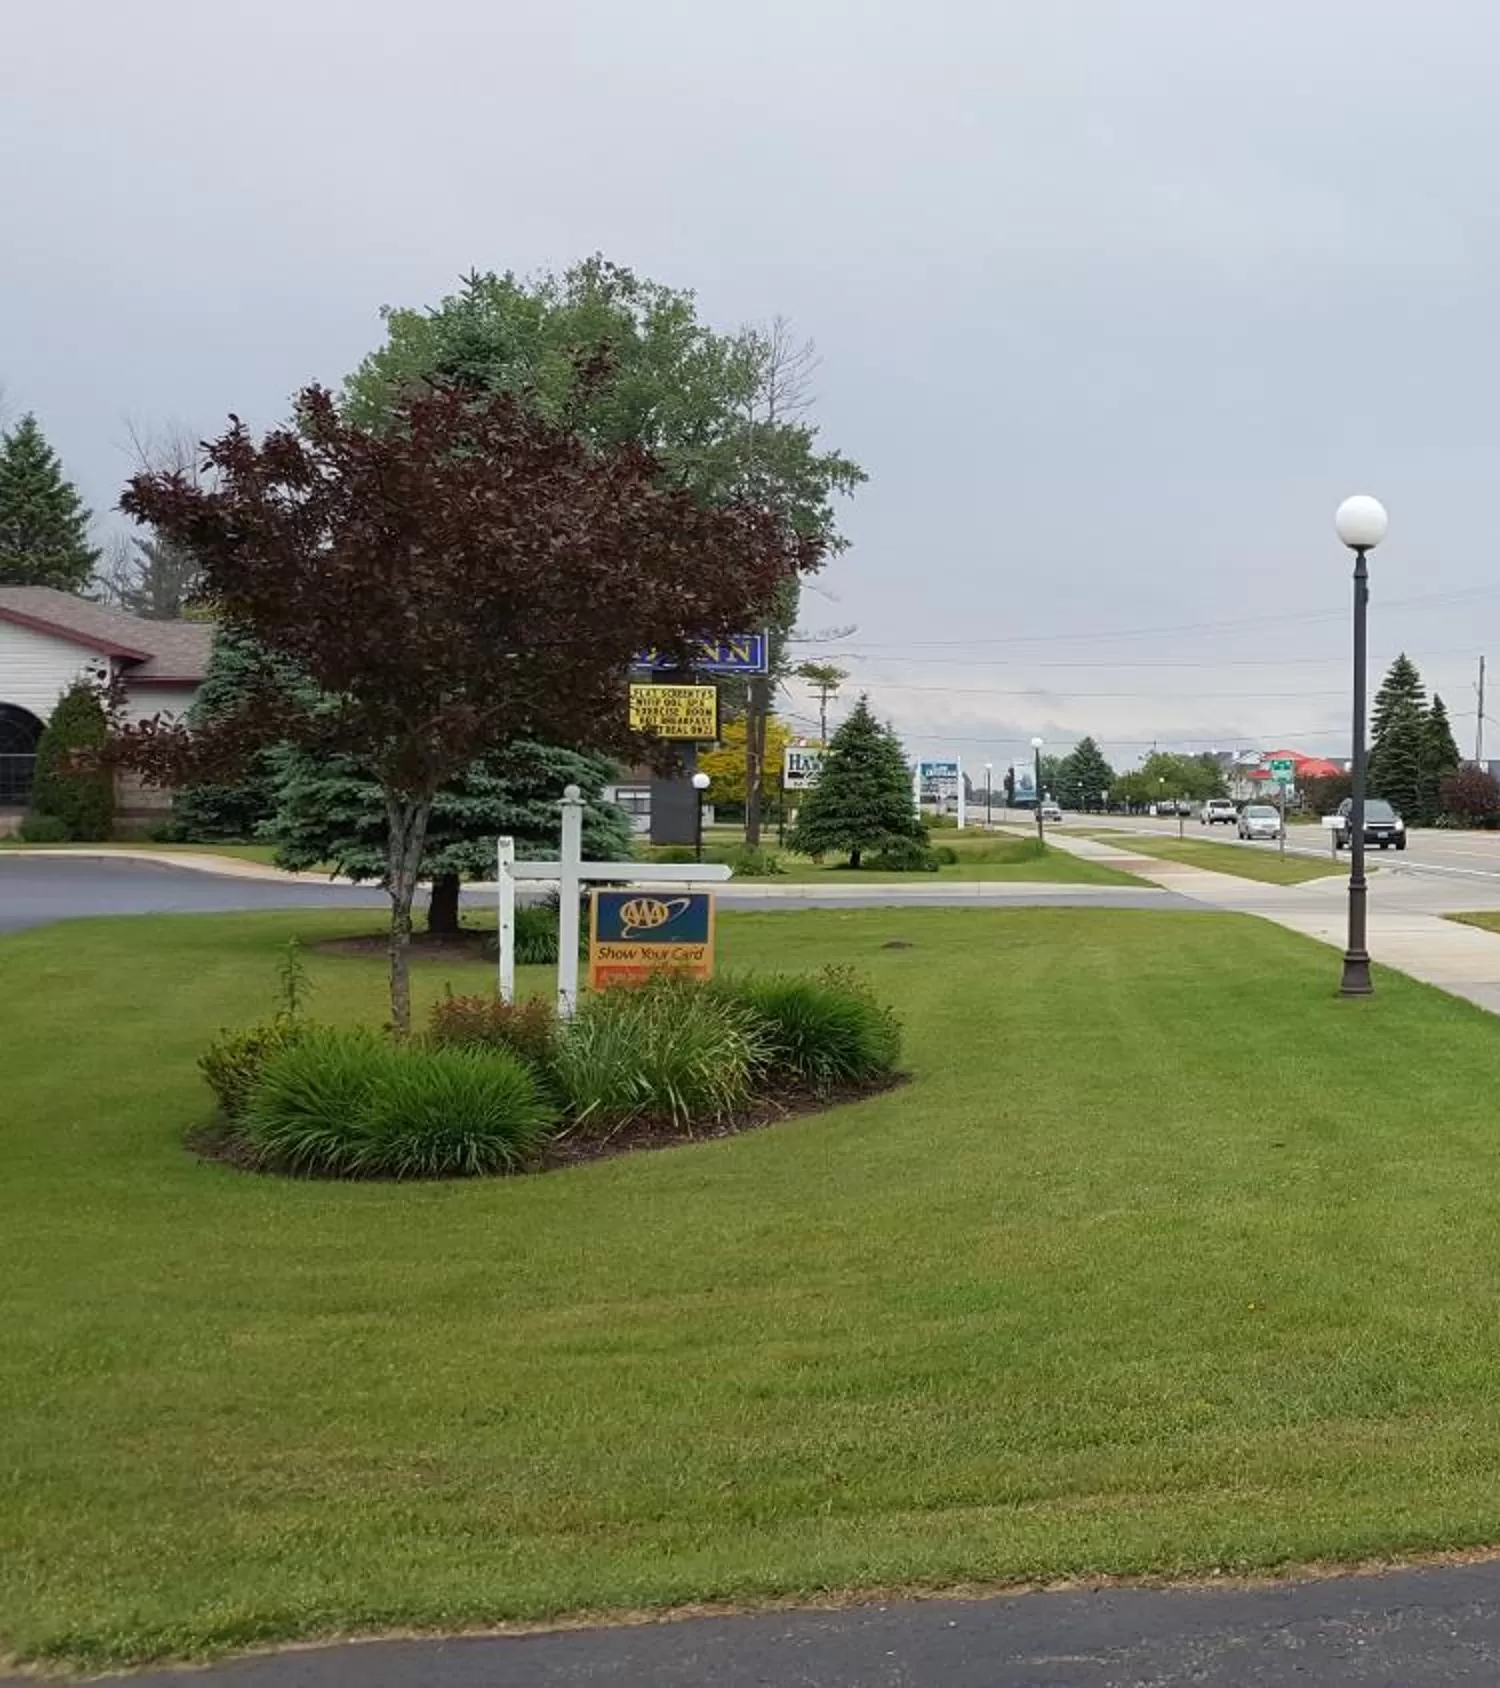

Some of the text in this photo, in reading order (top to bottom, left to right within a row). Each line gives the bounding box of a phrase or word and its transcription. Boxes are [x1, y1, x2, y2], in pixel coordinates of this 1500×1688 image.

[622, 898, 667, 927] AAA
[597, 946, 705, 961] Show Your Card
